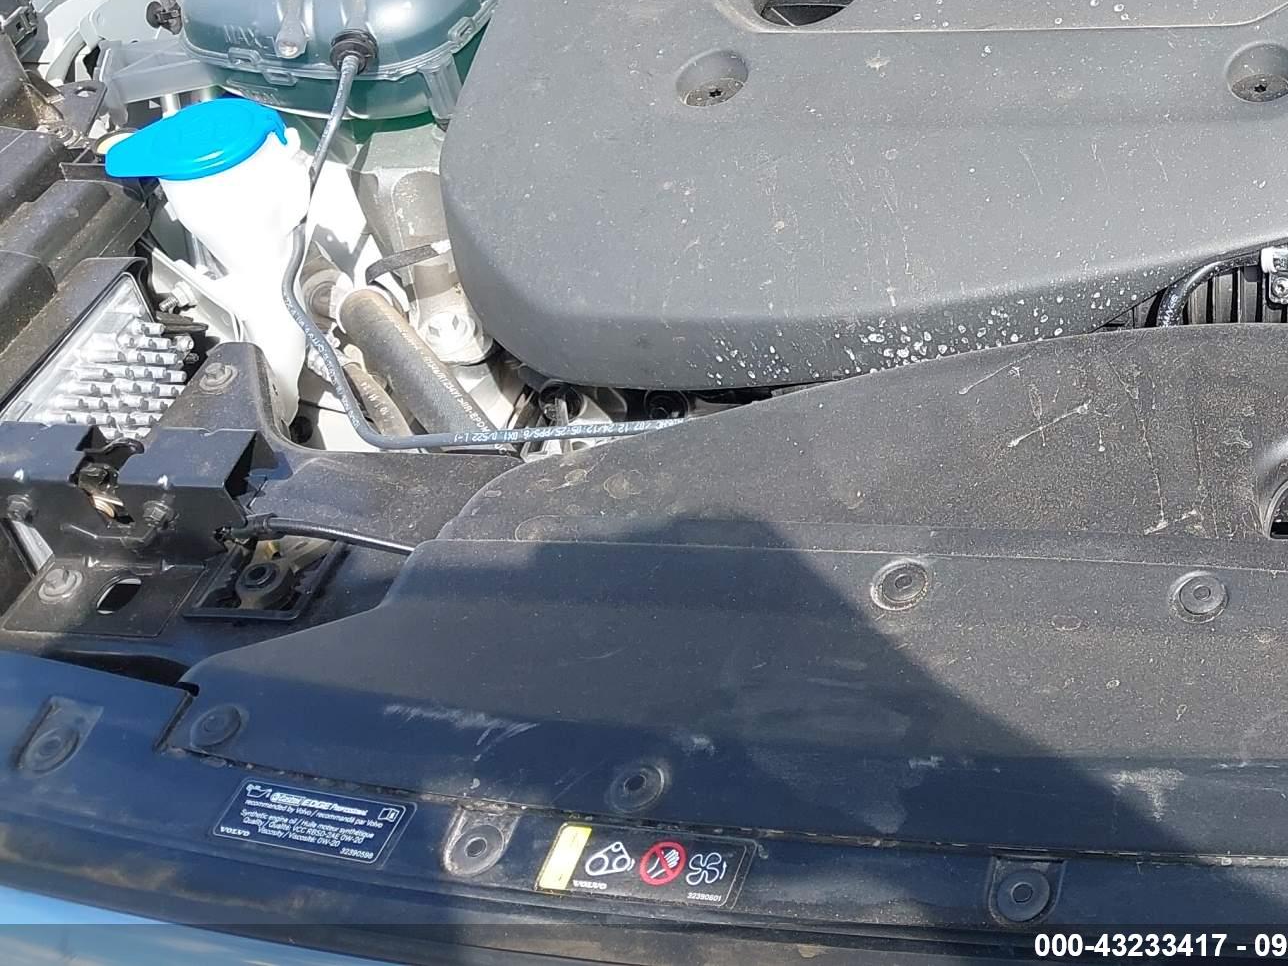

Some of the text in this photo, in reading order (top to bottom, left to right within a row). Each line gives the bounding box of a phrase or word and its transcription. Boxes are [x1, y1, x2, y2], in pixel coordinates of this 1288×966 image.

[301, 798, 332, 810] EDGE
[240, 809, 268, 819] Synthetic
[268, 815, 288, 823] engine
[301, 820, 317, 828] Huile
[245, 799, 287, 811] recommended
[366, 819, 383, 828] Volvo
[243, 816, 264, 827] Quality
[292, 825, 306, 833] VCC
[220, 826, 250, 836] VOLVO
[258, 826, 283, 837] Viscosity
[573, 880, 607, 890] VOLVO
